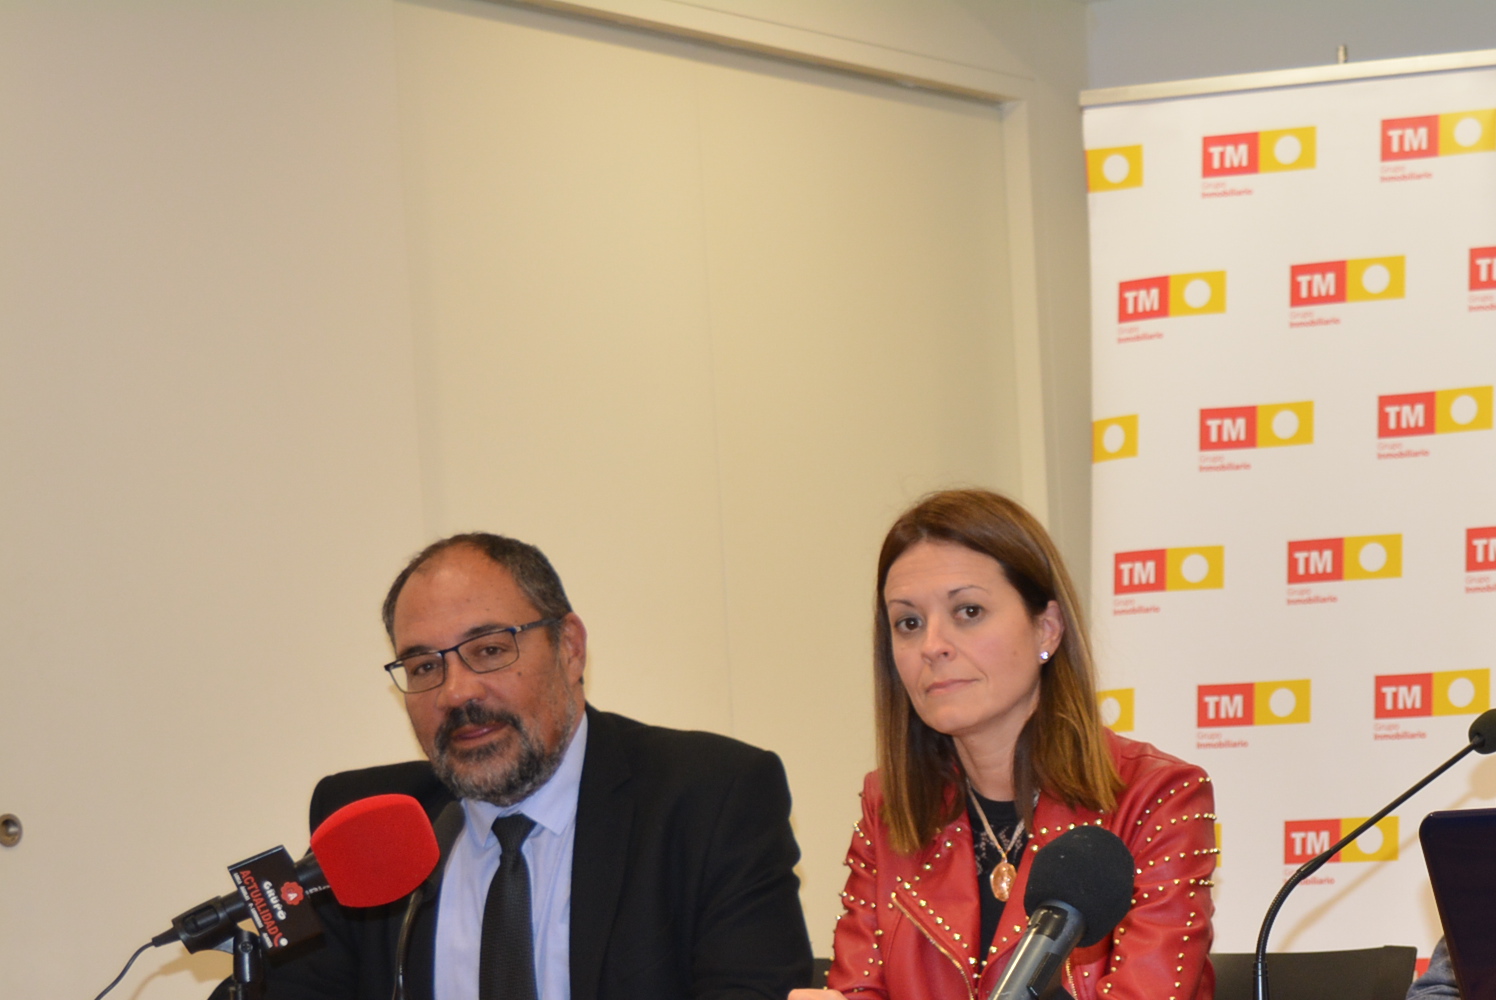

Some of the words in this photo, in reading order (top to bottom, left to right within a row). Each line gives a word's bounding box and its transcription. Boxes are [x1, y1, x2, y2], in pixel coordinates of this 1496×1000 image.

[1387, 126, 1428, 153] TM
[1208, 143, 1248, 169] TM
[1296, 272, 1336, 298] TM
[1124, 288, 1159, 314] TM
[1206, 417, 1246, 442] TM
[1385, 403, 1425, 430] TM
[1119, 561, 1156, 586] TM
[1294, 549, 1332, 575] TM
[1204, 694, 1243, 719] TM
[1381, 685, 1422, 710] TM
[1290, 830, 1330, 855] TM
[240, 870, 279, 935] ACTUALIDAD
[263, 881, 287, 920] GRUPO
